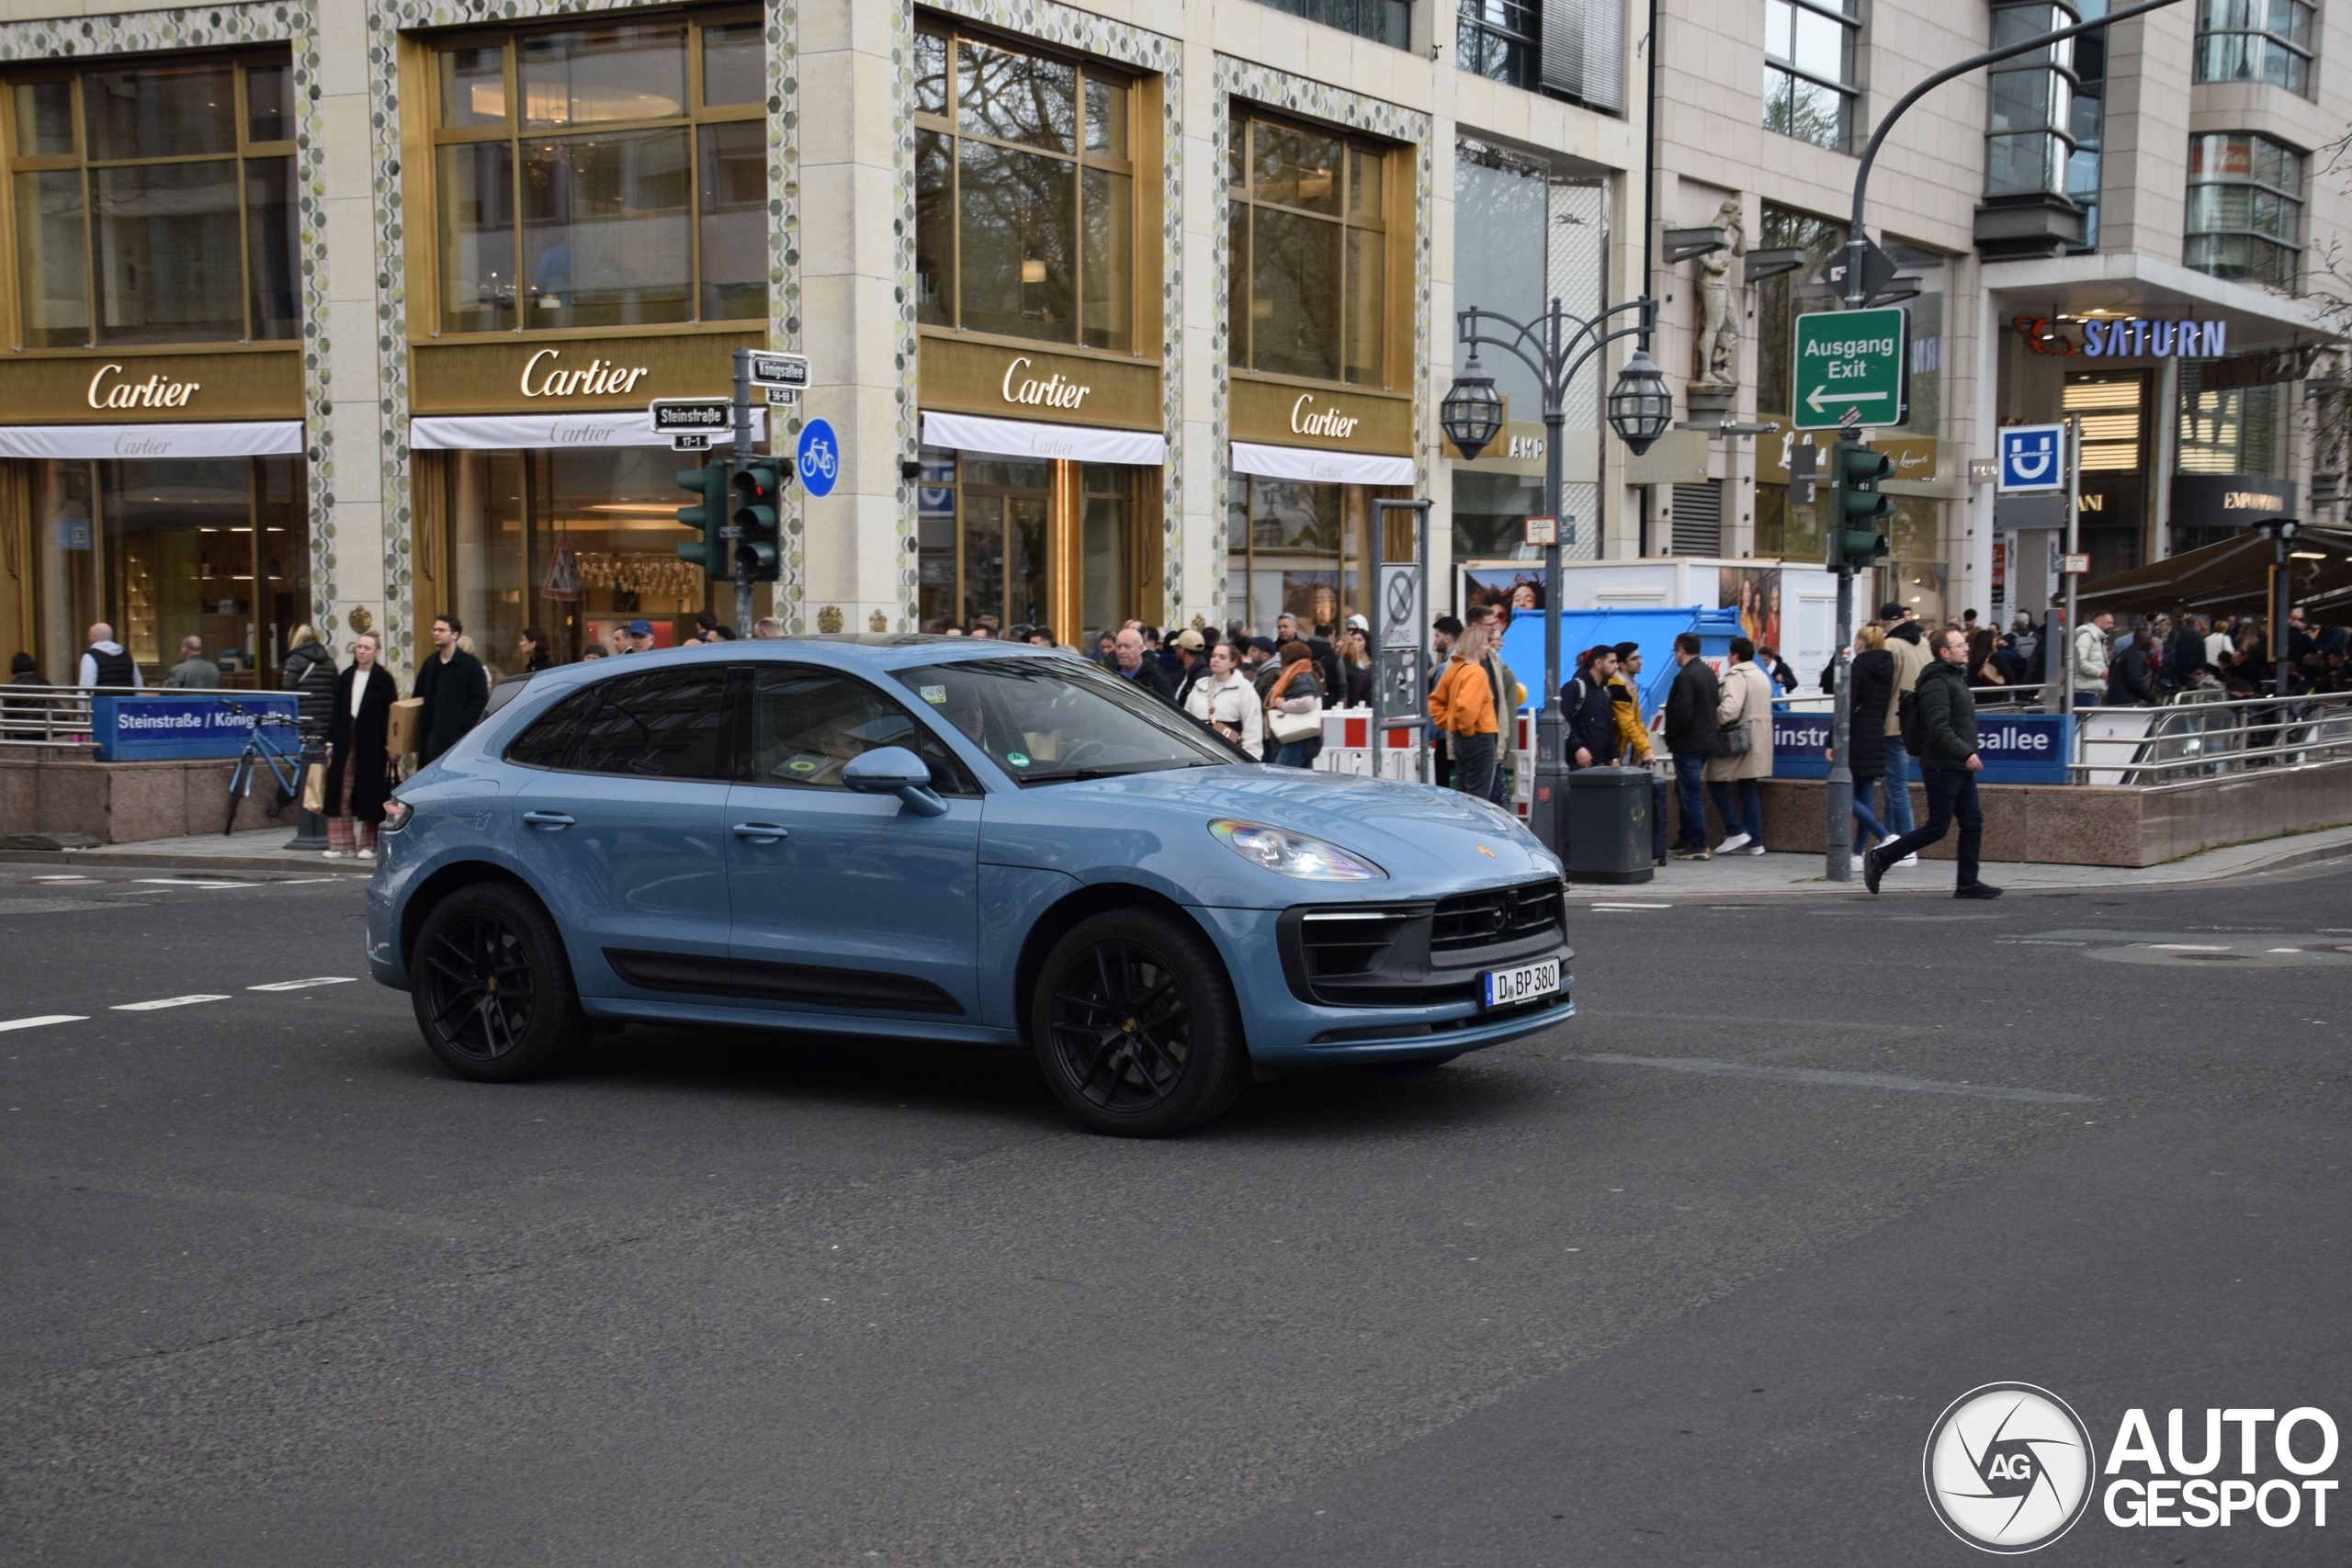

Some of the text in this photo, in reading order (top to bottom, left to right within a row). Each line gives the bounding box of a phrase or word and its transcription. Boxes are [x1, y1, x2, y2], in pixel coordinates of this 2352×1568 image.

[1804, 337, 1894, 359] Ausgang
[2084, 319, 2226, 357] SATURN
[521, 349, 648, 397] Cartier
[759, 361, 804, 379] Königsallee
[1827, 359, 1867, 379] Exit
[87, 364, 200, 410] Cartier
[1002, 356, 1091, 410] Cartier
[661, 407, 721, 424] Steinstraße
[1291, 393, 1359, 438] Cartier
[549, 418, 616, 444] Cartier
[682, 436, 701, 447] 17-1
[114, 432, 172, 455] Cartier
[1030, 429, 1076, 457] Cartier
[1310, 456, 1346, 479] Cartier
[1389, 629, 1411, 643] ZONE
[118, 712, 202, 729] Steinstraße
[214, 711, 292, 729] Königalle
[1498, 964, 1555, 999] D BP 380
